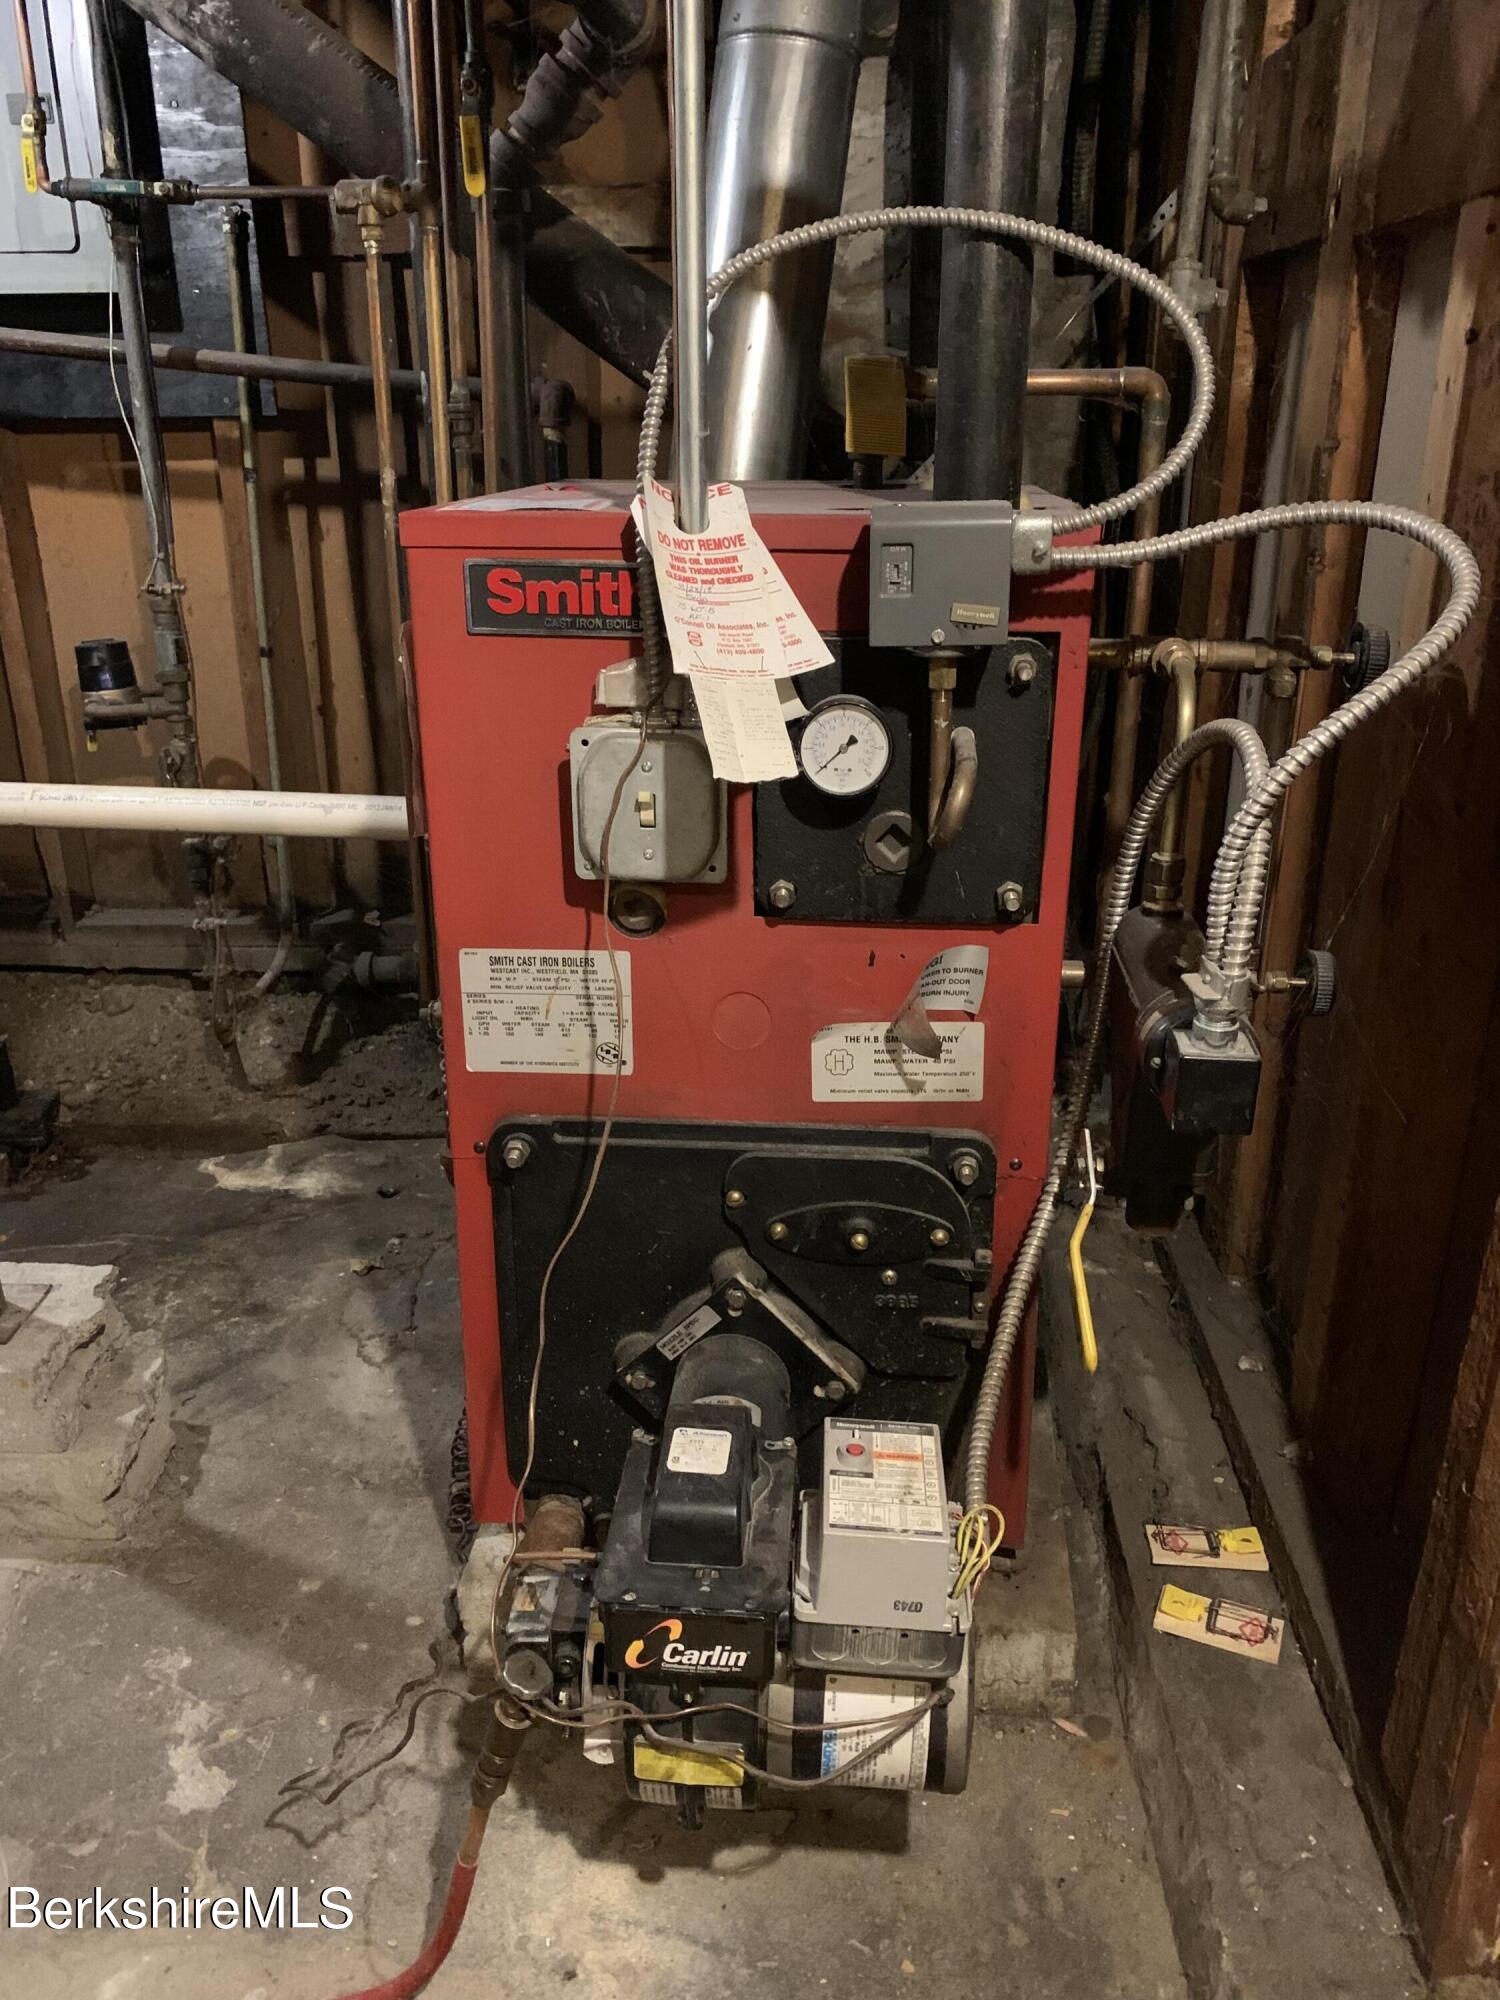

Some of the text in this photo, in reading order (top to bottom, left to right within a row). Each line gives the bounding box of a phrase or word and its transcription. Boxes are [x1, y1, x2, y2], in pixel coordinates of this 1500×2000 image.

[657, 530, 746, 551] DO NOT REMOVE
[669, 553, 739, 566] THIS OIL BURNER
[669, 563, 744, 575] WAS THOROUGHLY
[665, 570, 754, 585] CLEANED and CHECKED
[957, 608, 995, 620] Honeywell
[544, 617, 643, 630] CAST IRON BOILE
[489, 955, 595, 968] SMITH CAST IRON BOILERS
[953, 967, 984, 976] BURNER
[845, 1035, 861, 1043] THE
[863, 1035, 883, 1043] H.B.
[836, 1421, 876, 1430] Honeywell
[893, 1599, 923, 1613] 0743
[662, 1642, 748, 1667] Carlin
